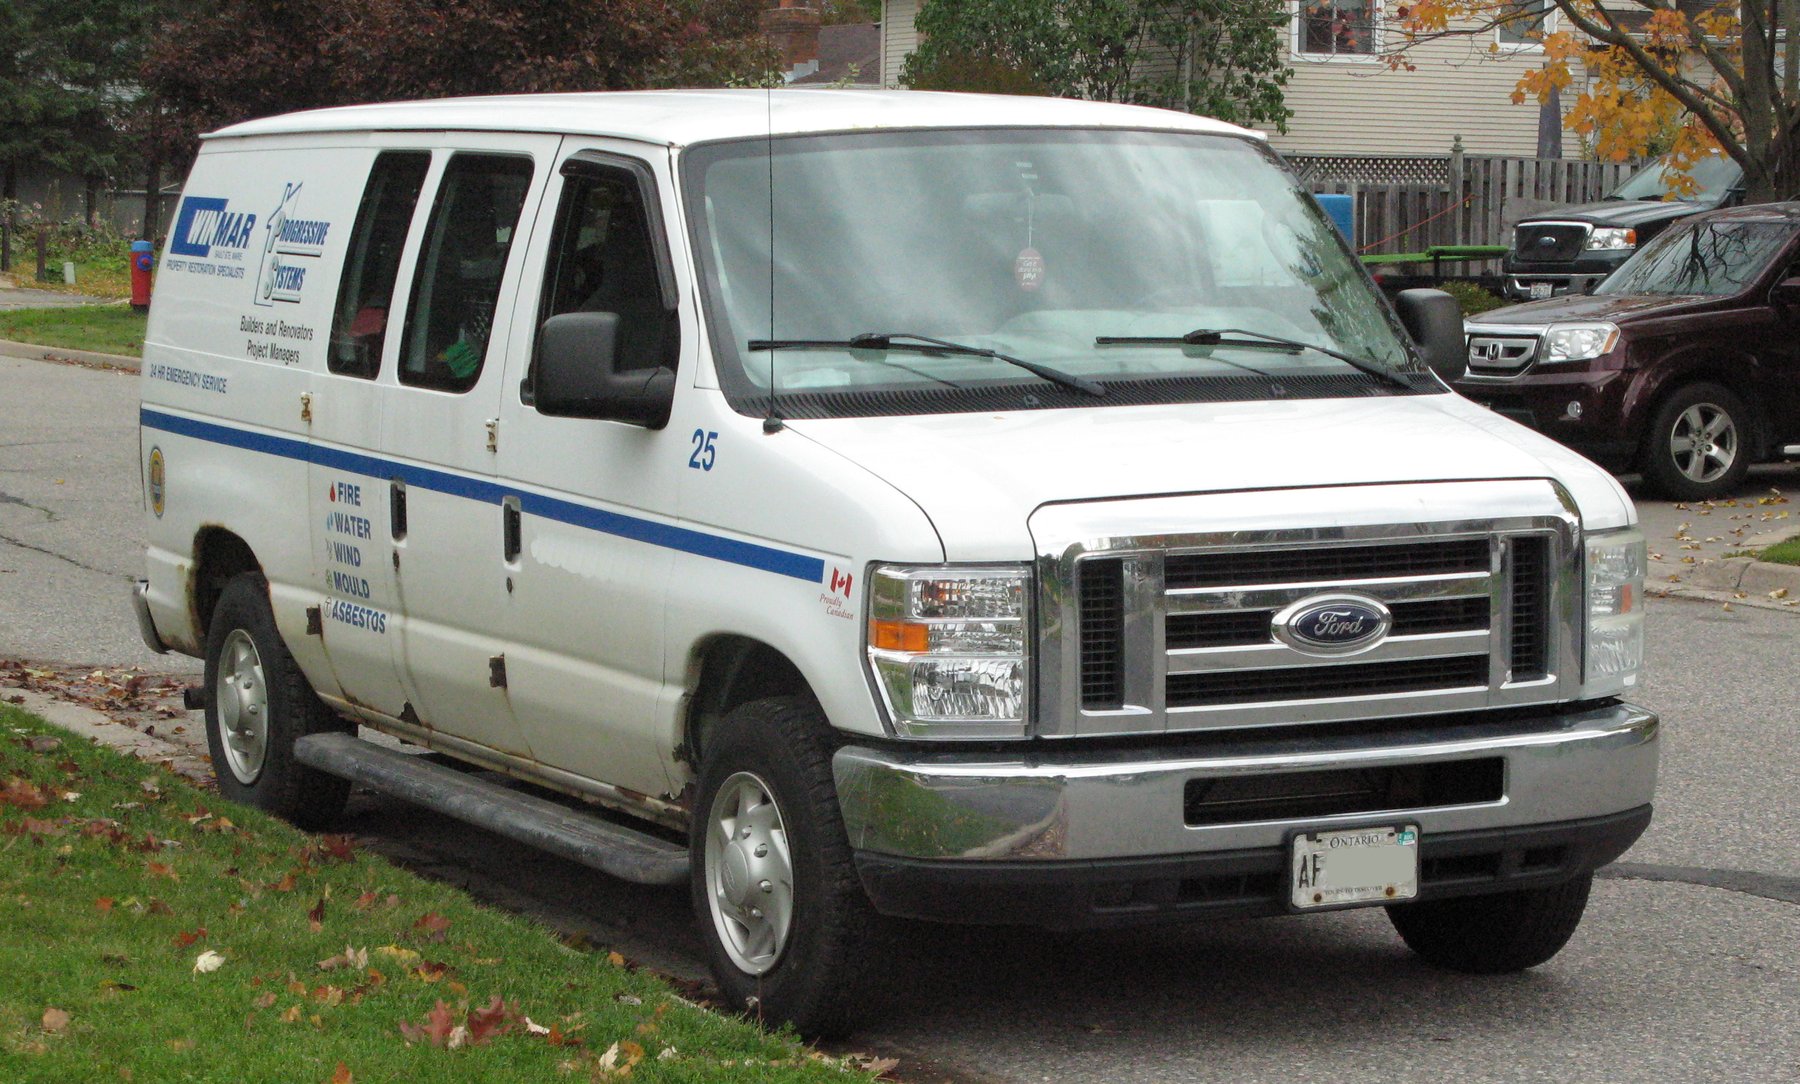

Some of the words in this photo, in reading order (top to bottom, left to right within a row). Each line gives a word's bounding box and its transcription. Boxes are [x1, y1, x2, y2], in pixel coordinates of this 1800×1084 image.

[187, 209, 256, 249] WINMAR
[267, 211, 330, 253] PROGRESSIVE
[166, 259, 188, 272] PROPERTY
[188, 261, 216, 276] RESTORATION
[217, 265, 245, 279] SPECIALISTS
[263, 255, 306, 300] SYSTEMS
[240, 315, 264, 334] Builders
[265, 319, 277, 336] and
[278, 320, 313, 341] Renovators
[247, 340, 268, 359] Project
[269, 343, 300, 364] Managers
[150, 363, 157, 379] 24
[157, 364, 166, 380] HR
[166, 365, 201, 389] EMERGENCY
[201, 373, 227, 393] SERVICE
[689, 428, 718, 471] 25
[338, 482, 361, 507] FIRE
[334, 512, 371, 540] WATER
[333, 541, 361, 567] WIND
[333, 571, 370, 598] MOULD
[819, 593, 842, 608] Proudly
[826, 605, 854, 620] Canadian
[332, 600, 386, 634] ASBESTOS
[1313, 611, 1364, 636] Ford
